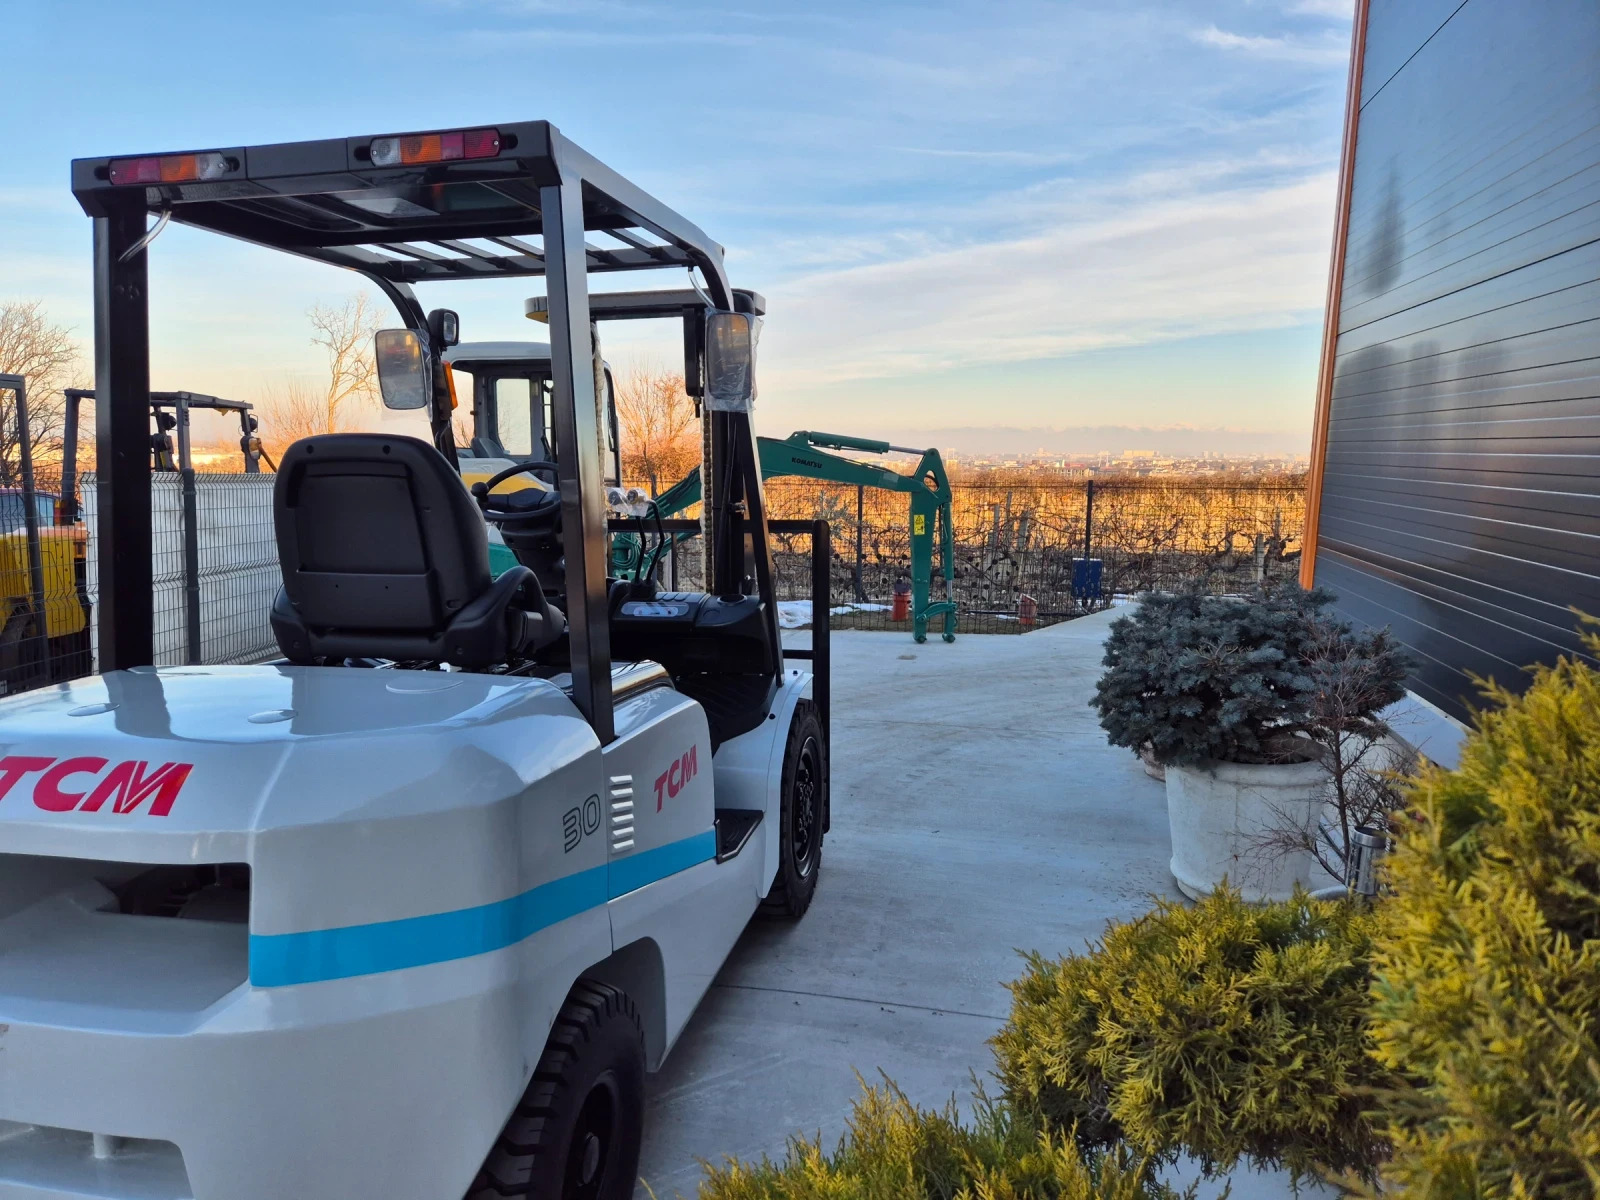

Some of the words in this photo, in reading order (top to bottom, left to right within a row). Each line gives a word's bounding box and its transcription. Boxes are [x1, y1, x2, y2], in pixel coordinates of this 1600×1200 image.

[791, 457, 823, 469] KOMATSU
[0, 756, 194, 816] TCM
[653, 744, 698, 813] TCM
[563, 794, 600, 854] 30
